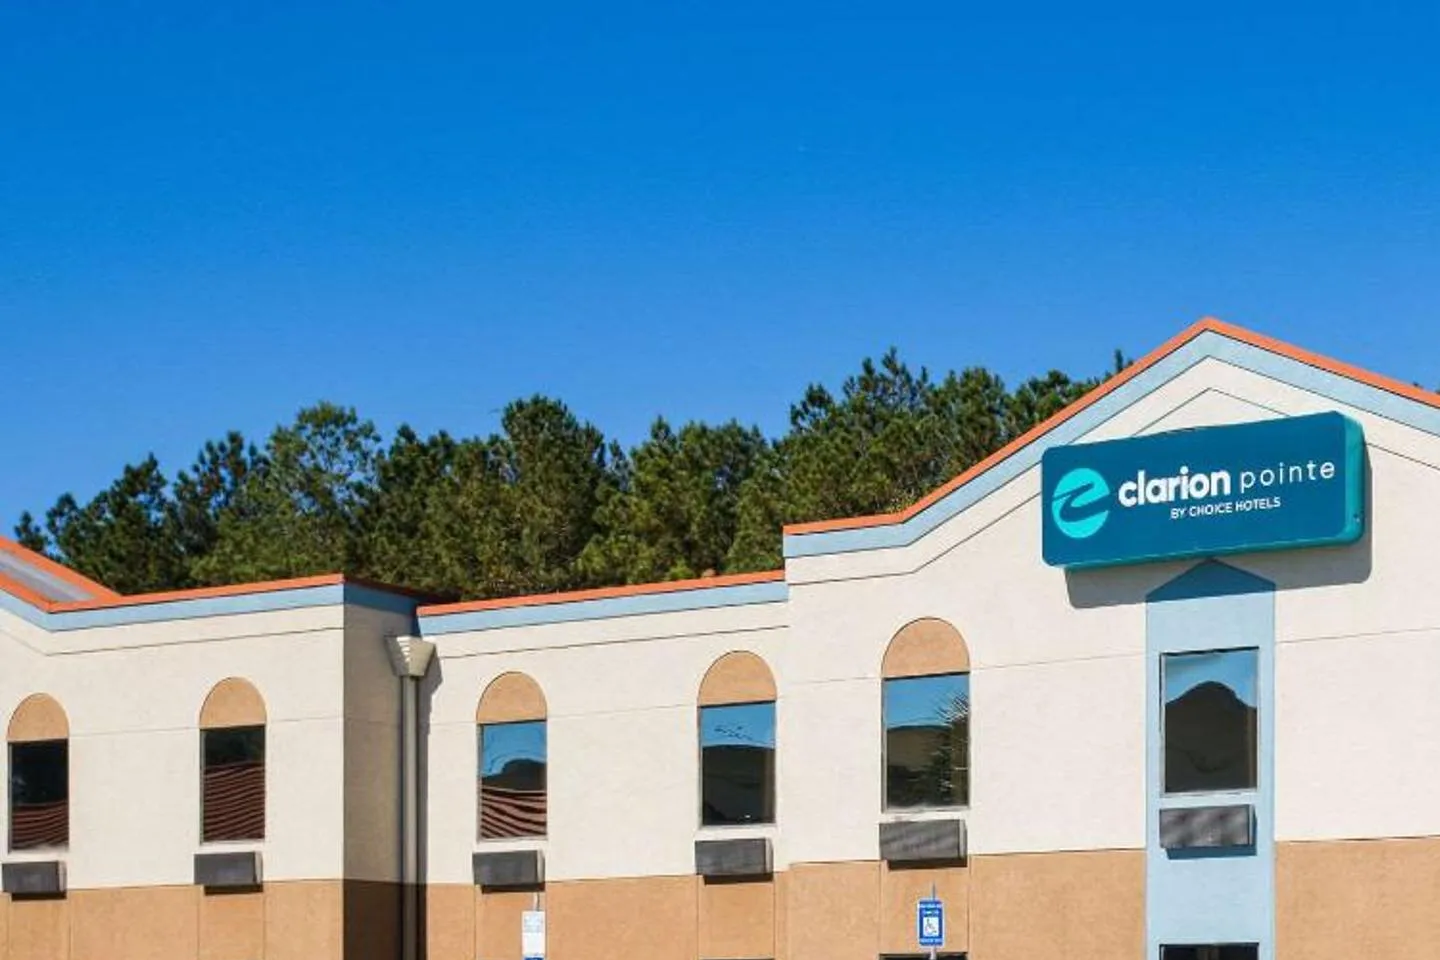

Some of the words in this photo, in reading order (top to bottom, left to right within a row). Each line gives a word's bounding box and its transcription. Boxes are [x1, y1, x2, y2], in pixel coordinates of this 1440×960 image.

[1118, 465, 1231, 507] clarion
[1239, 459, 1336, 494] pointe
[1170, 507, 1187, 519] BY
[1189, 502, 1233, 517] CHOICE
[1235, 497, 1281, 512] HOTELS
